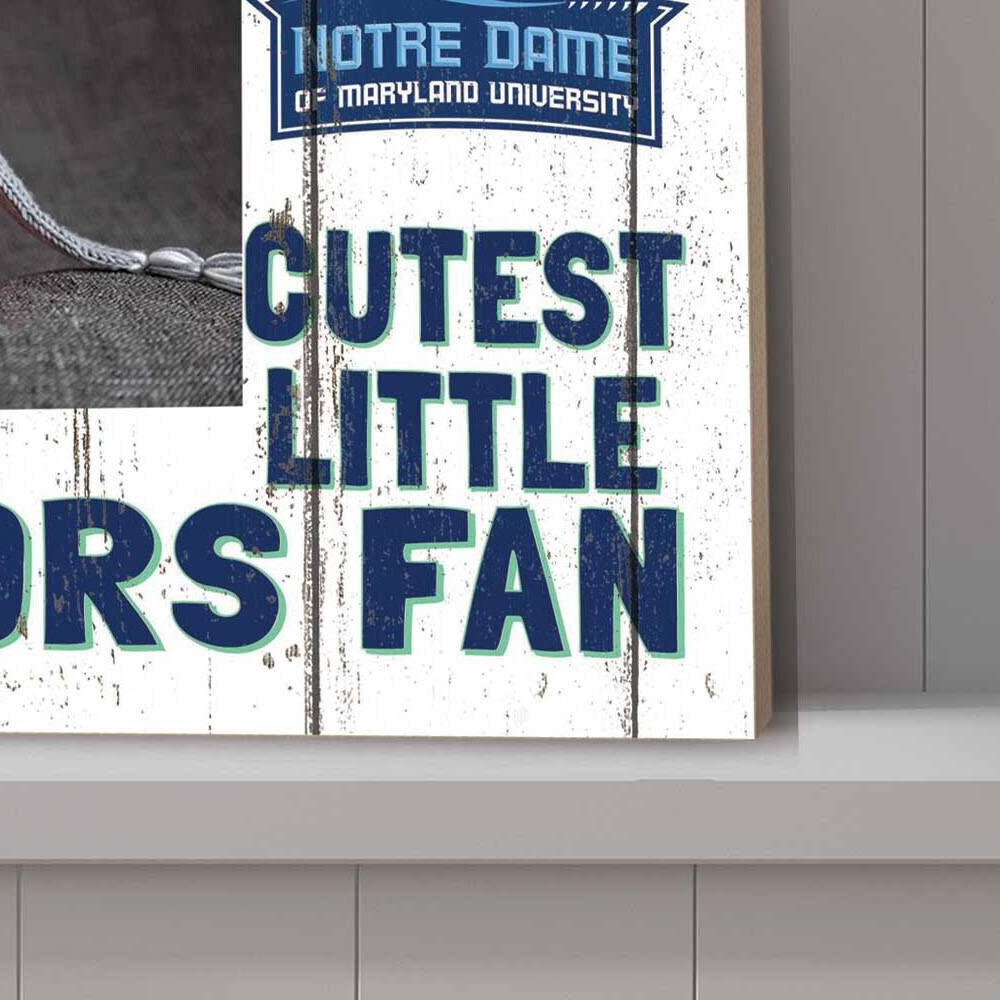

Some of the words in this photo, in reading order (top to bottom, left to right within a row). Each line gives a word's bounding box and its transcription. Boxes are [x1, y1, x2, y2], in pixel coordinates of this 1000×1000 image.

[291, 21, 461, 75] NOTRE
[483, 20, 637, 82] DAME
[338, 80, 479, 108] MARYLAND
[489, 81, 638, 118] UNIVERSITY
[244, 221, 687, 350] CUTEST
[267, 367, 662, 494] LITTLE
[362, 505, 686, 659] FAN
